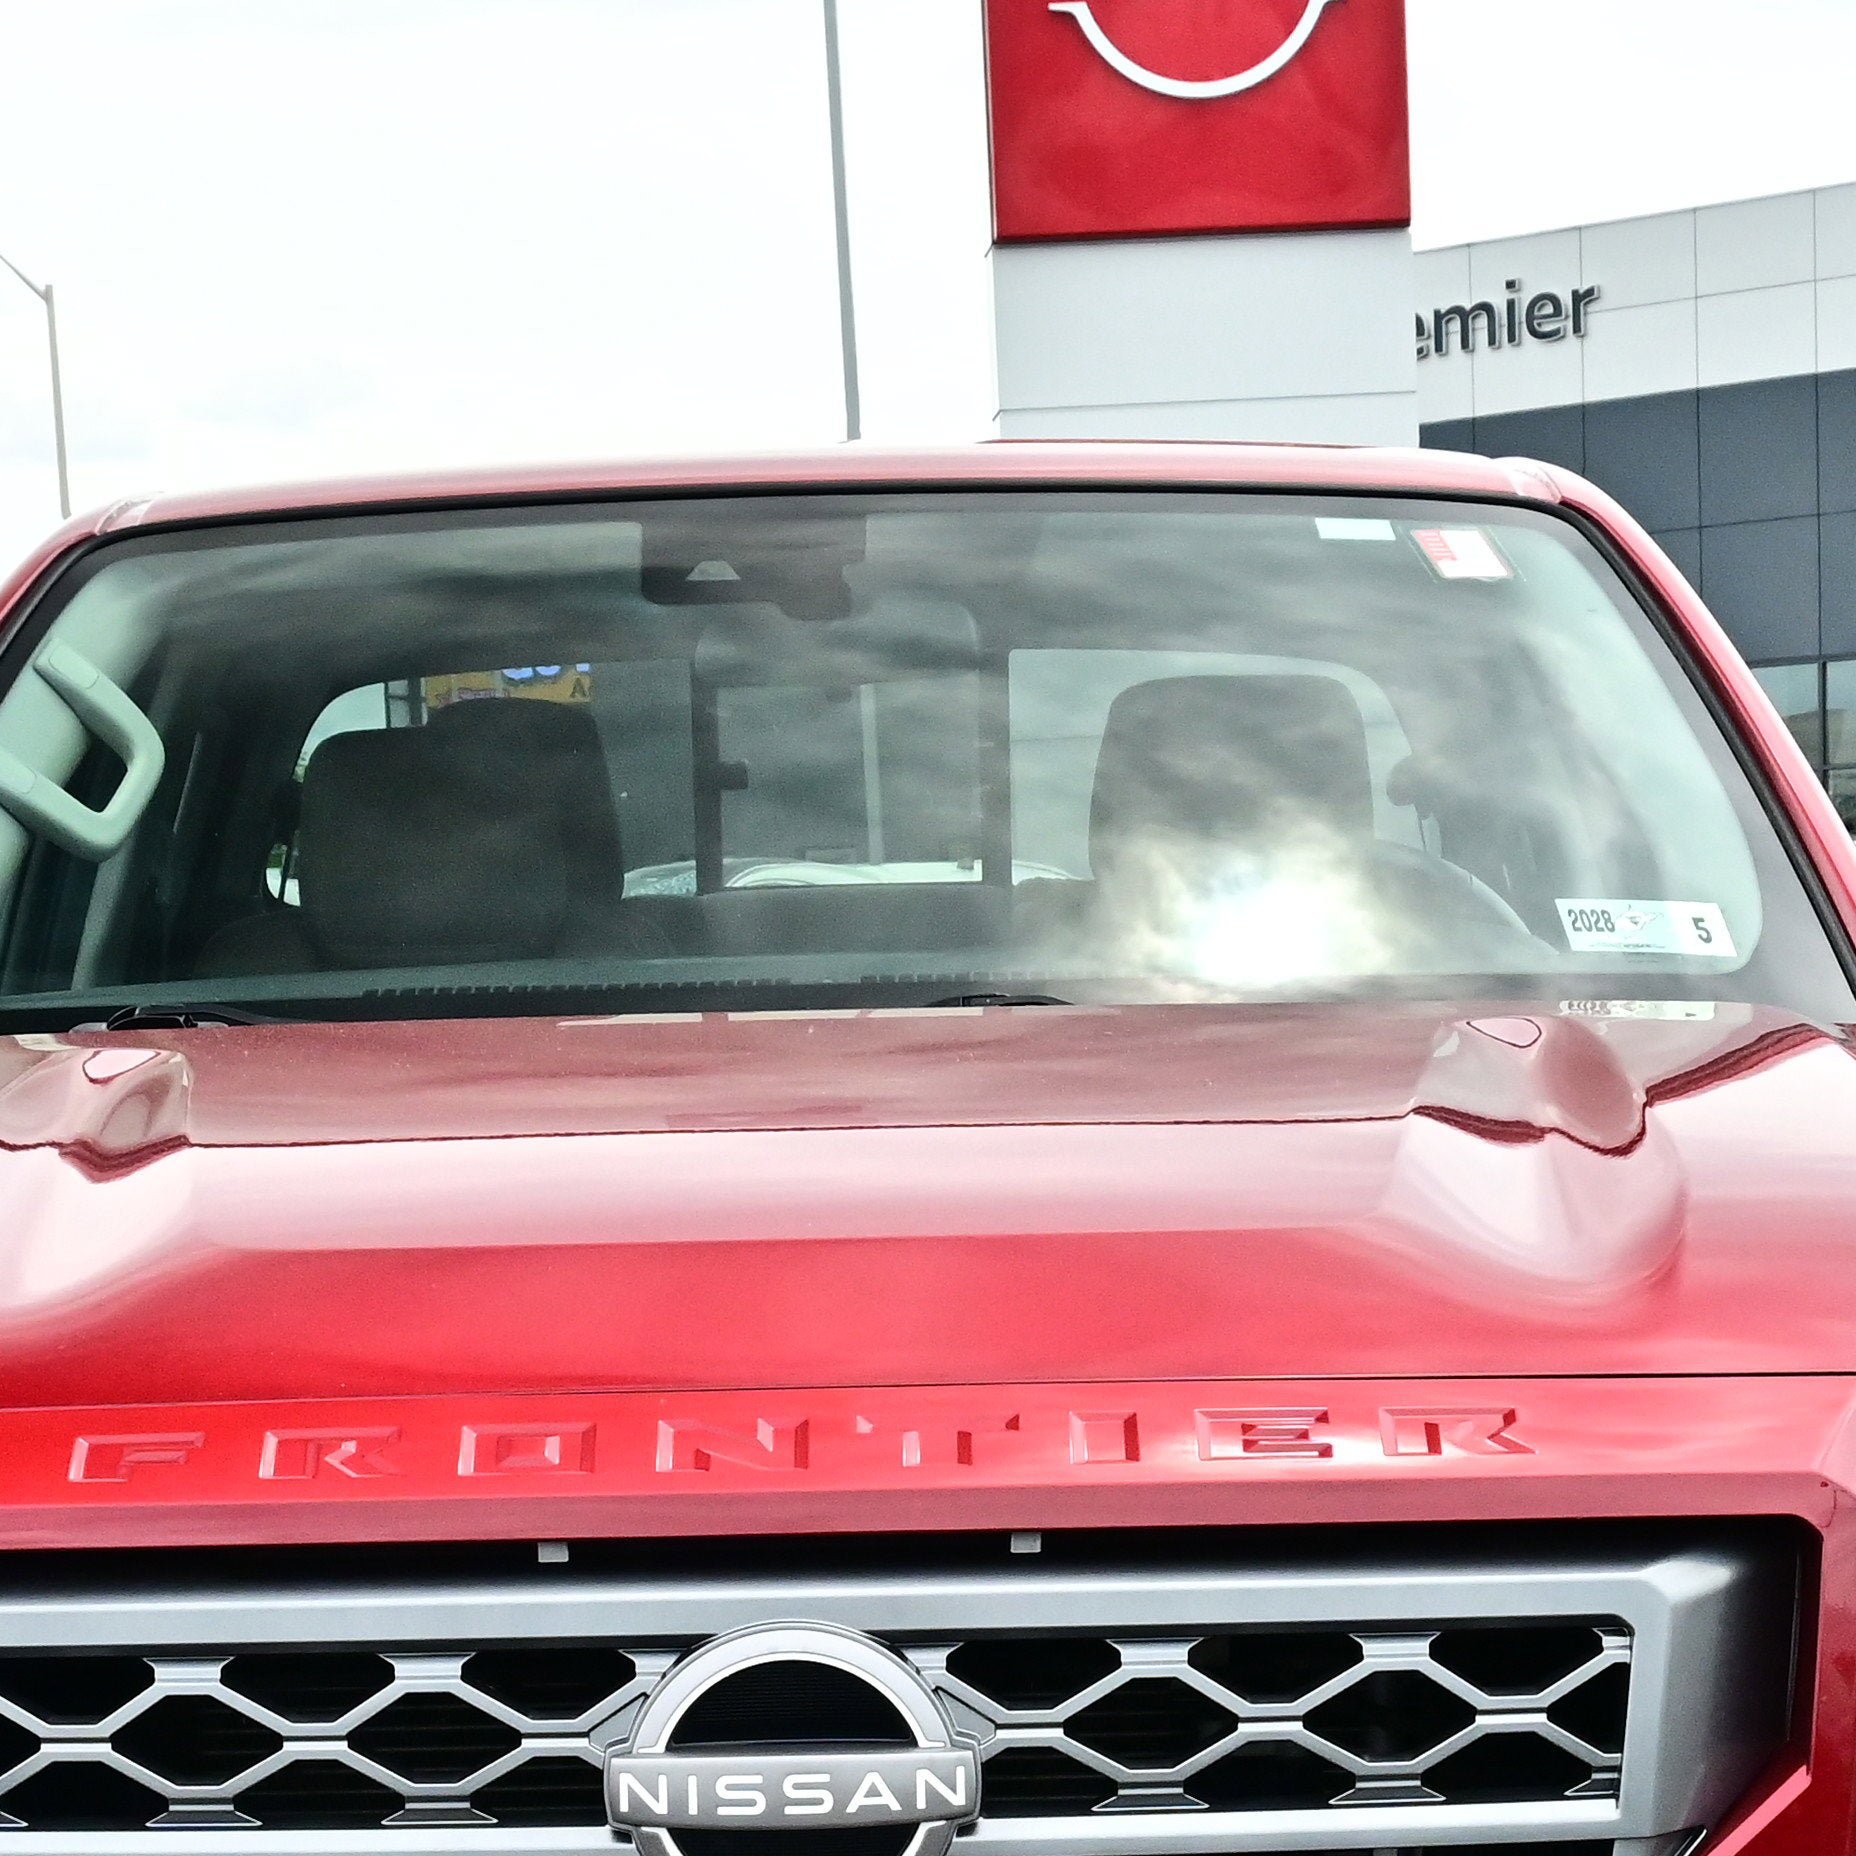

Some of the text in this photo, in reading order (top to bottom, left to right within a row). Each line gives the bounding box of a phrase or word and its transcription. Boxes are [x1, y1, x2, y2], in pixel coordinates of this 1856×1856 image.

[1567, 908, 1713, 944] 2028 5
[66, 1406, 1540, 1484] FRONTIER
[618, 1765, 967, 1817] NISSAN
